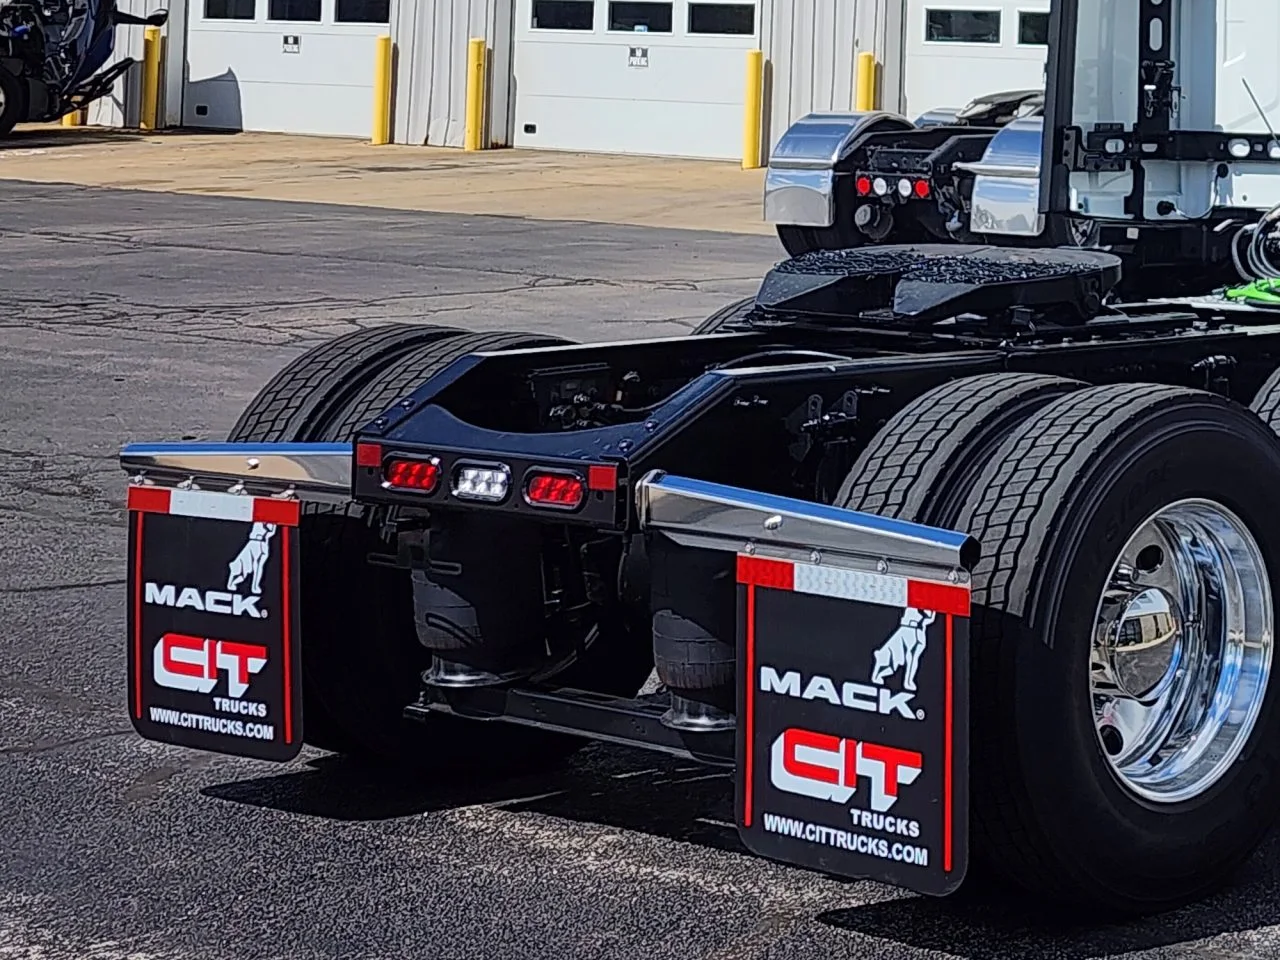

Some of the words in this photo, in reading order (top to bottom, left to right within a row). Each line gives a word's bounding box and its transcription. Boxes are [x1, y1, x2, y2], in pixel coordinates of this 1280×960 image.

[153, 632, 268, 698] CIT
[149, 707, 274, 741] WWW.CITTRUCKS.COM
[213, 697, 267, 717] TRUCKS
[771, 727, 923, 812] CIT
[764, 813, 929, 867] WWW.CITTRUCKS.COM
[850, 808, 920, 838] TRUCKS
